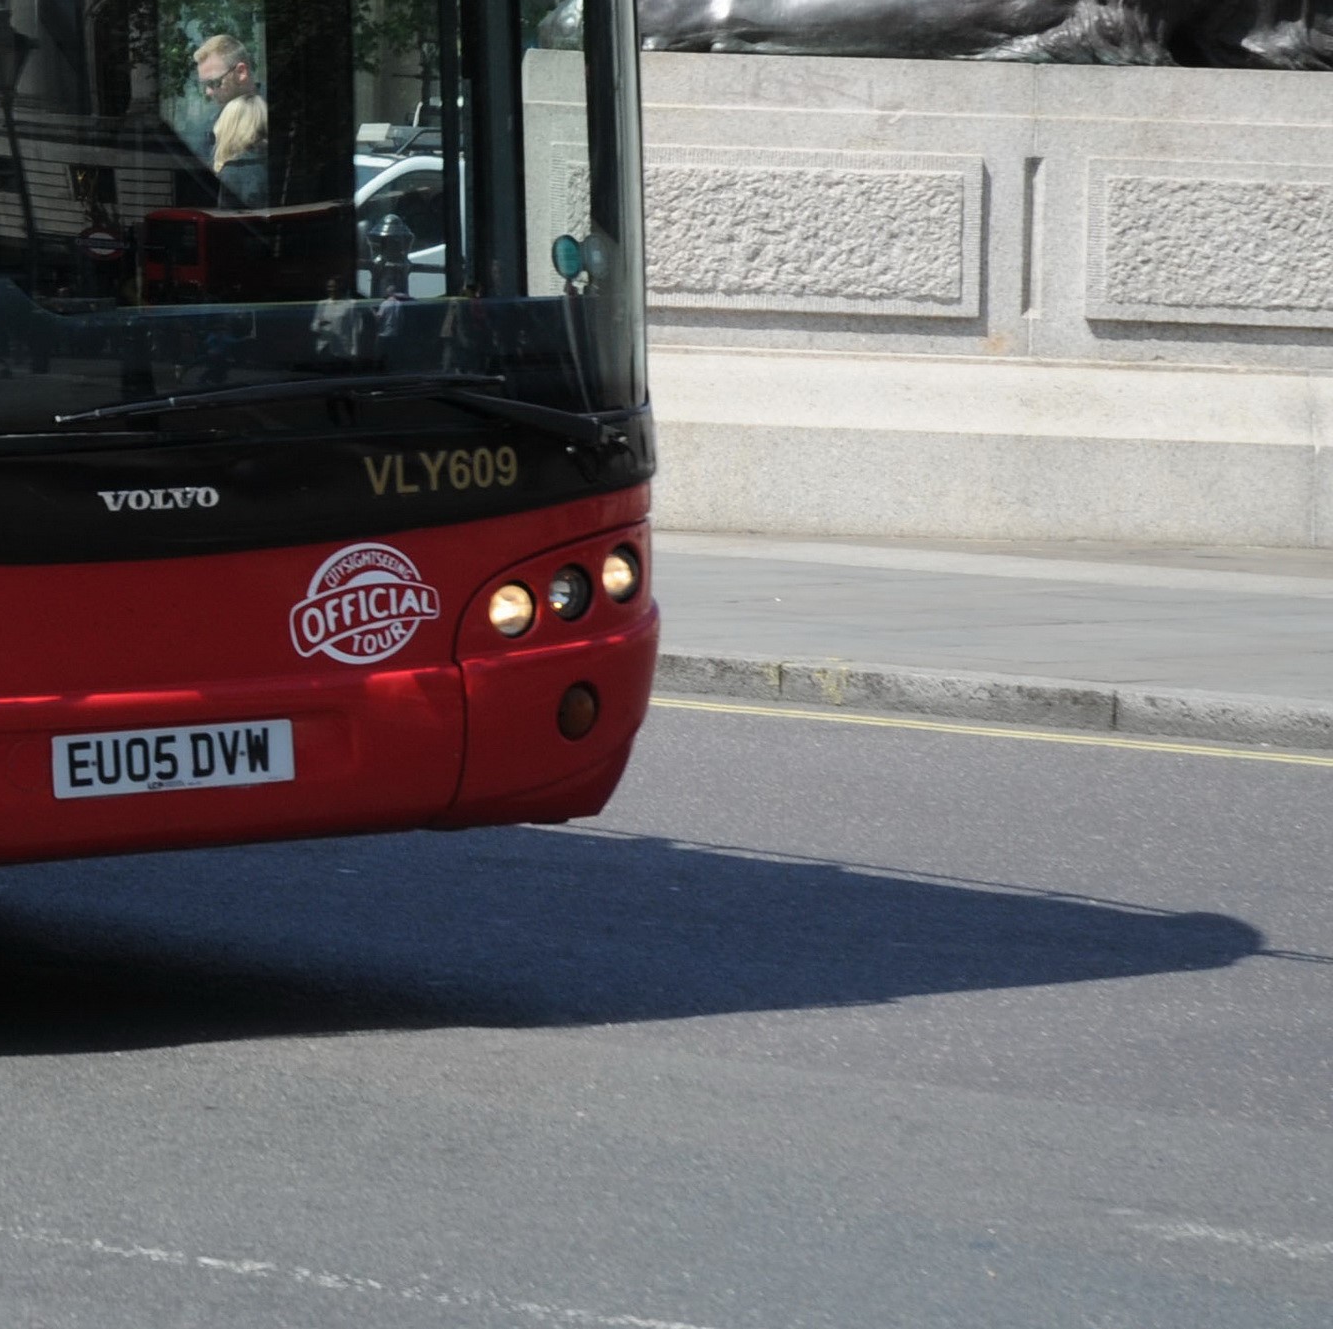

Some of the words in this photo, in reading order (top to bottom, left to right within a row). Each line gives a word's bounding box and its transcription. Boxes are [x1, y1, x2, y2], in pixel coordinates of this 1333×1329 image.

[364, 446, 518, 495] VLY609
[97, 486, 220, 511] VOLVO
[324, 551, 413, 588] CITYSIGHTSEEING
[302, 587, 437, 643] OFFICIAL
[352, 621, 408, 654] TOUR
[67, 734, 179, 788] EU05
[189, 727, 270, 778] DVW
